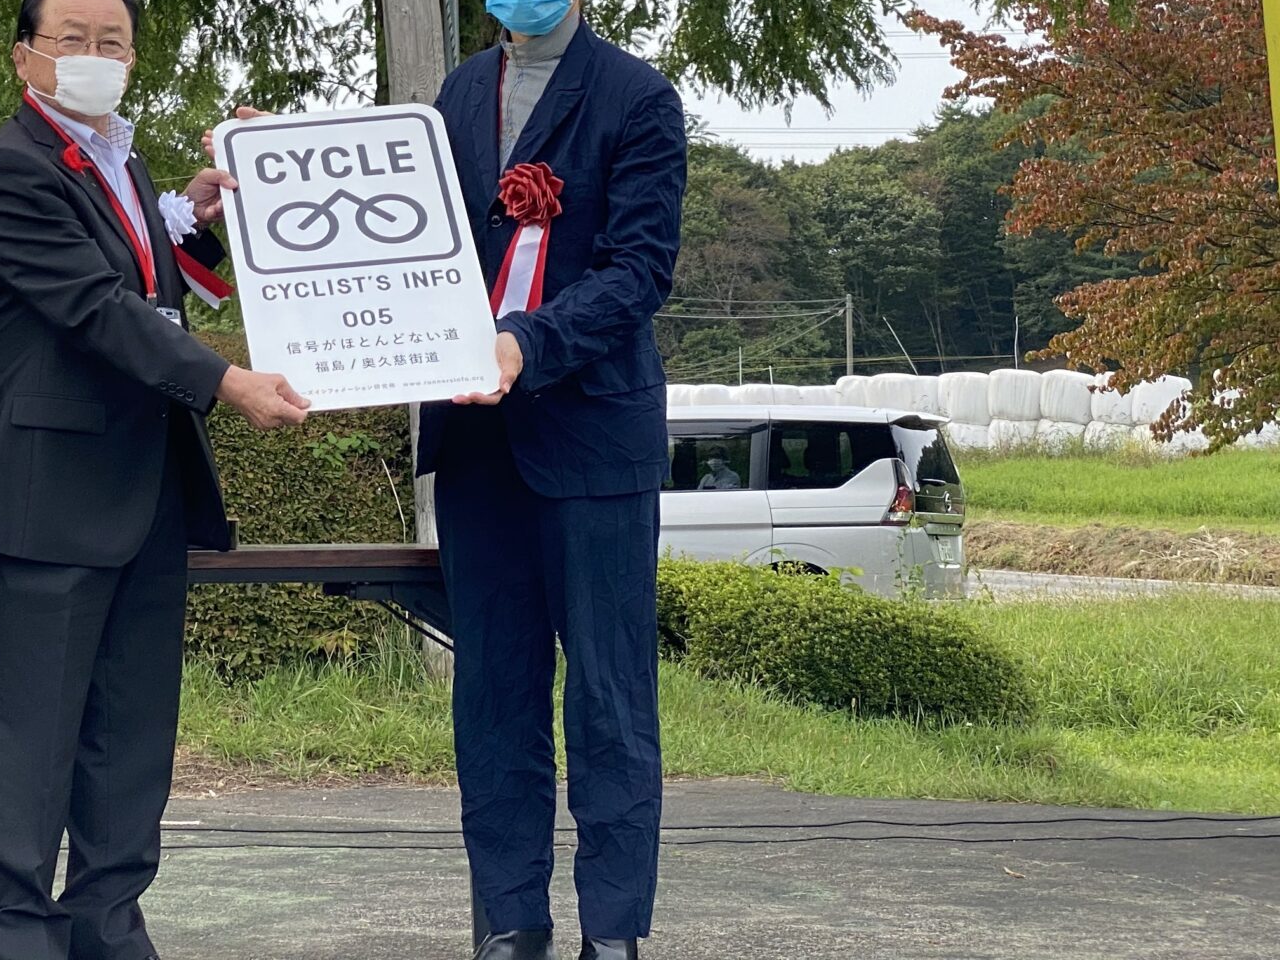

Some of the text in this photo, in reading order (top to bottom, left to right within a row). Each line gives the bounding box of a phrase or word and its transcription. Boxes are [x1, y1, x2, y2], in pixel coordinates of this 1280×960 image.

[254, 140, 416, 184] CYCLE
[261, 268, 462, 301] CYCLIST'S INFO
[342, 307, 394, 328] 005
[286, 328, 460, 355] 信号がほとんどない道
